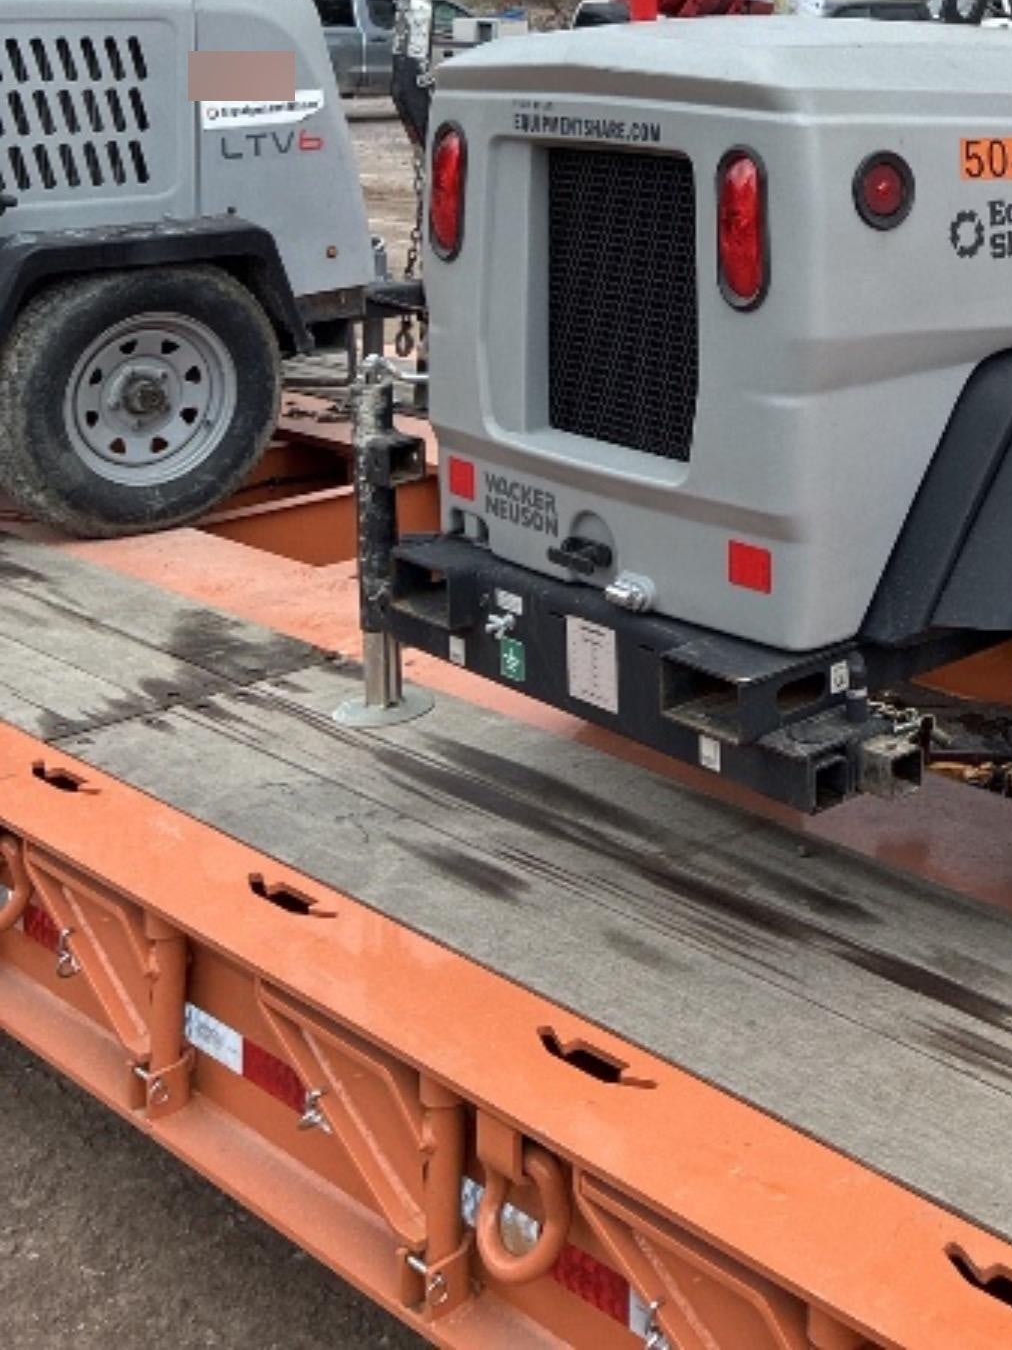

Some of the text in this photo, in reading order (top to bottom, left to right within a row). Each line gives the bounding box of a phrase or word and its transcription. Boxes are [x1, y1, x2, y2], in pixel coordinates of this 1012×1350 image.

[220, 128, 325, 160] LTV6
[484, 471, 556, 514] WACKER
[485, 493, 559, 539] NEUSON
